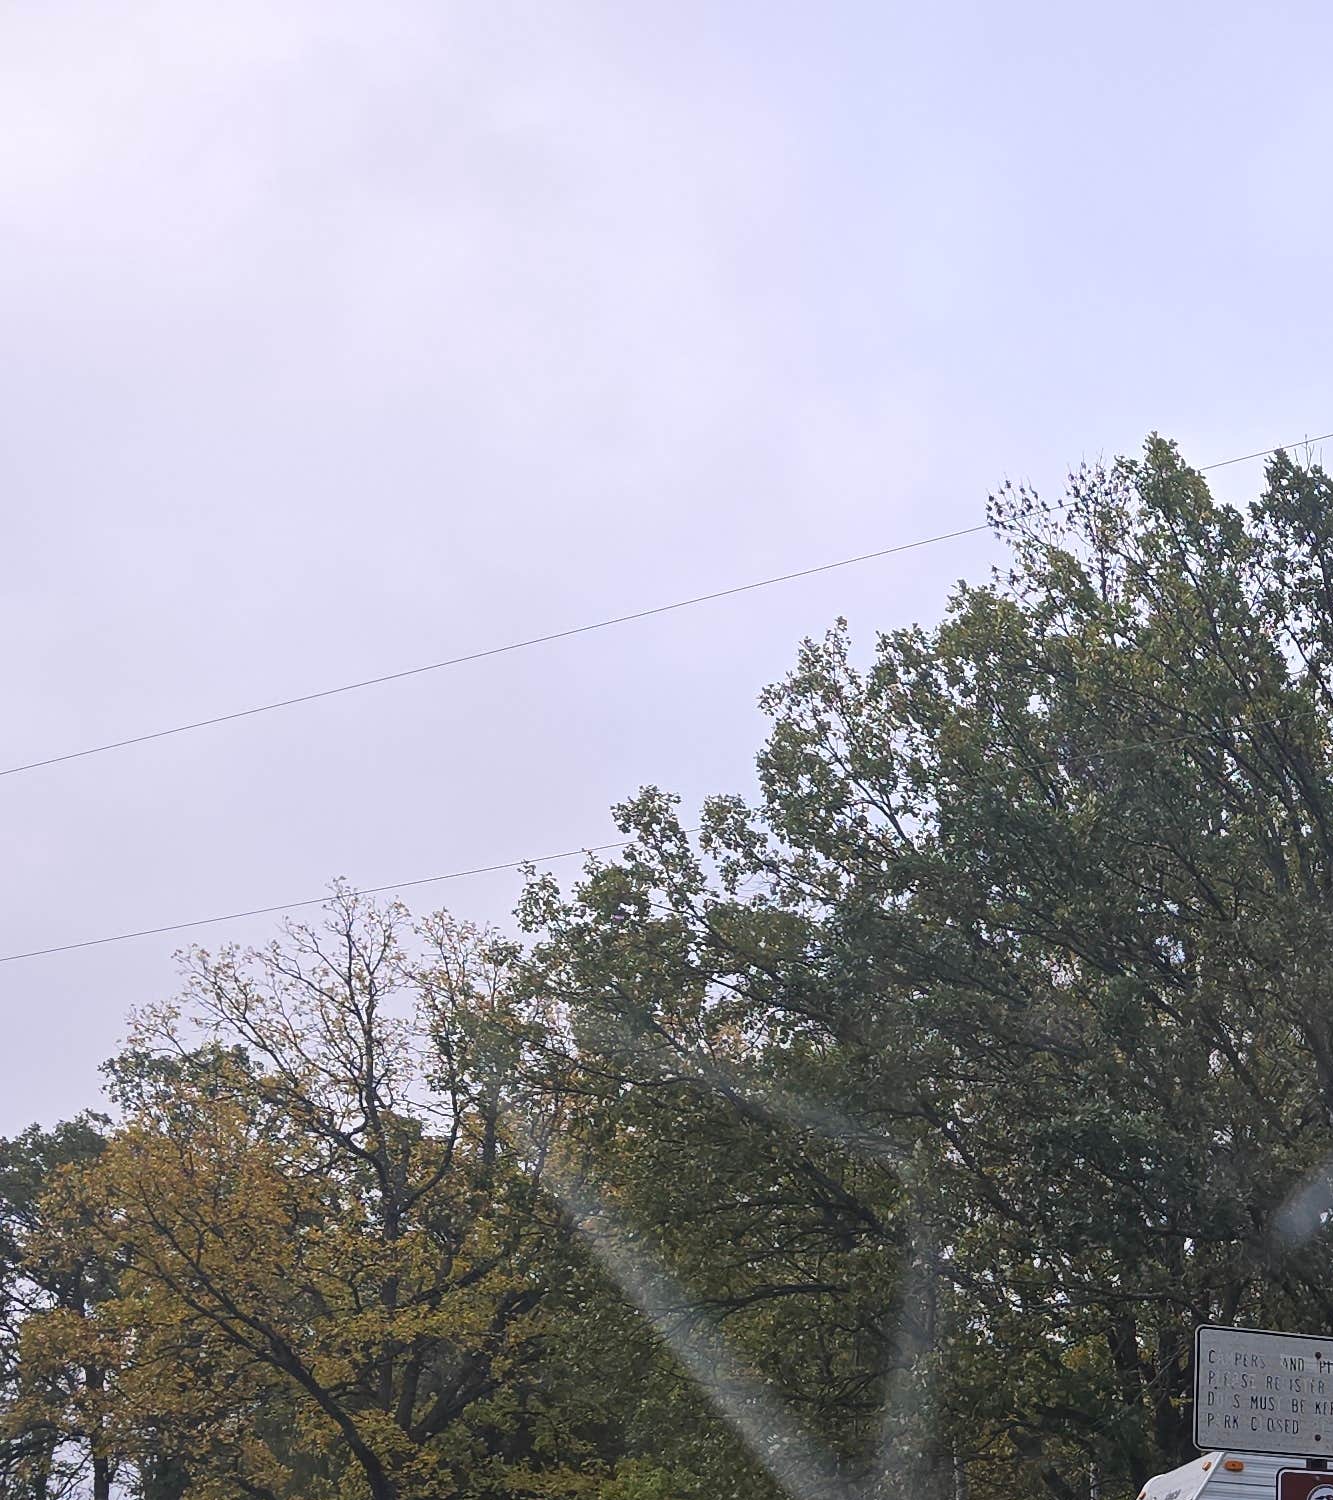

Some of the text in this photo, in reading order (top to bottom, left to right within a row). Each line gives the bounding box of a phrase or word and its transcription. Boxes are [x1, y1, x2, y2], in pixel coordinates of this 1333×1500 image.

[1208, 1349, 1267, 1370] CPERS
[1281, 1356, 1305, 1373] AND
[1207, 1391, 1241, 1409] DS
[1249, 1395, 1281, 1411] MUS
[1291, 1397, 1305, 1414] BE
[1207, 1412, 1239, 1430] PRK
[1250, 1416, 1300, 1435] COSED
